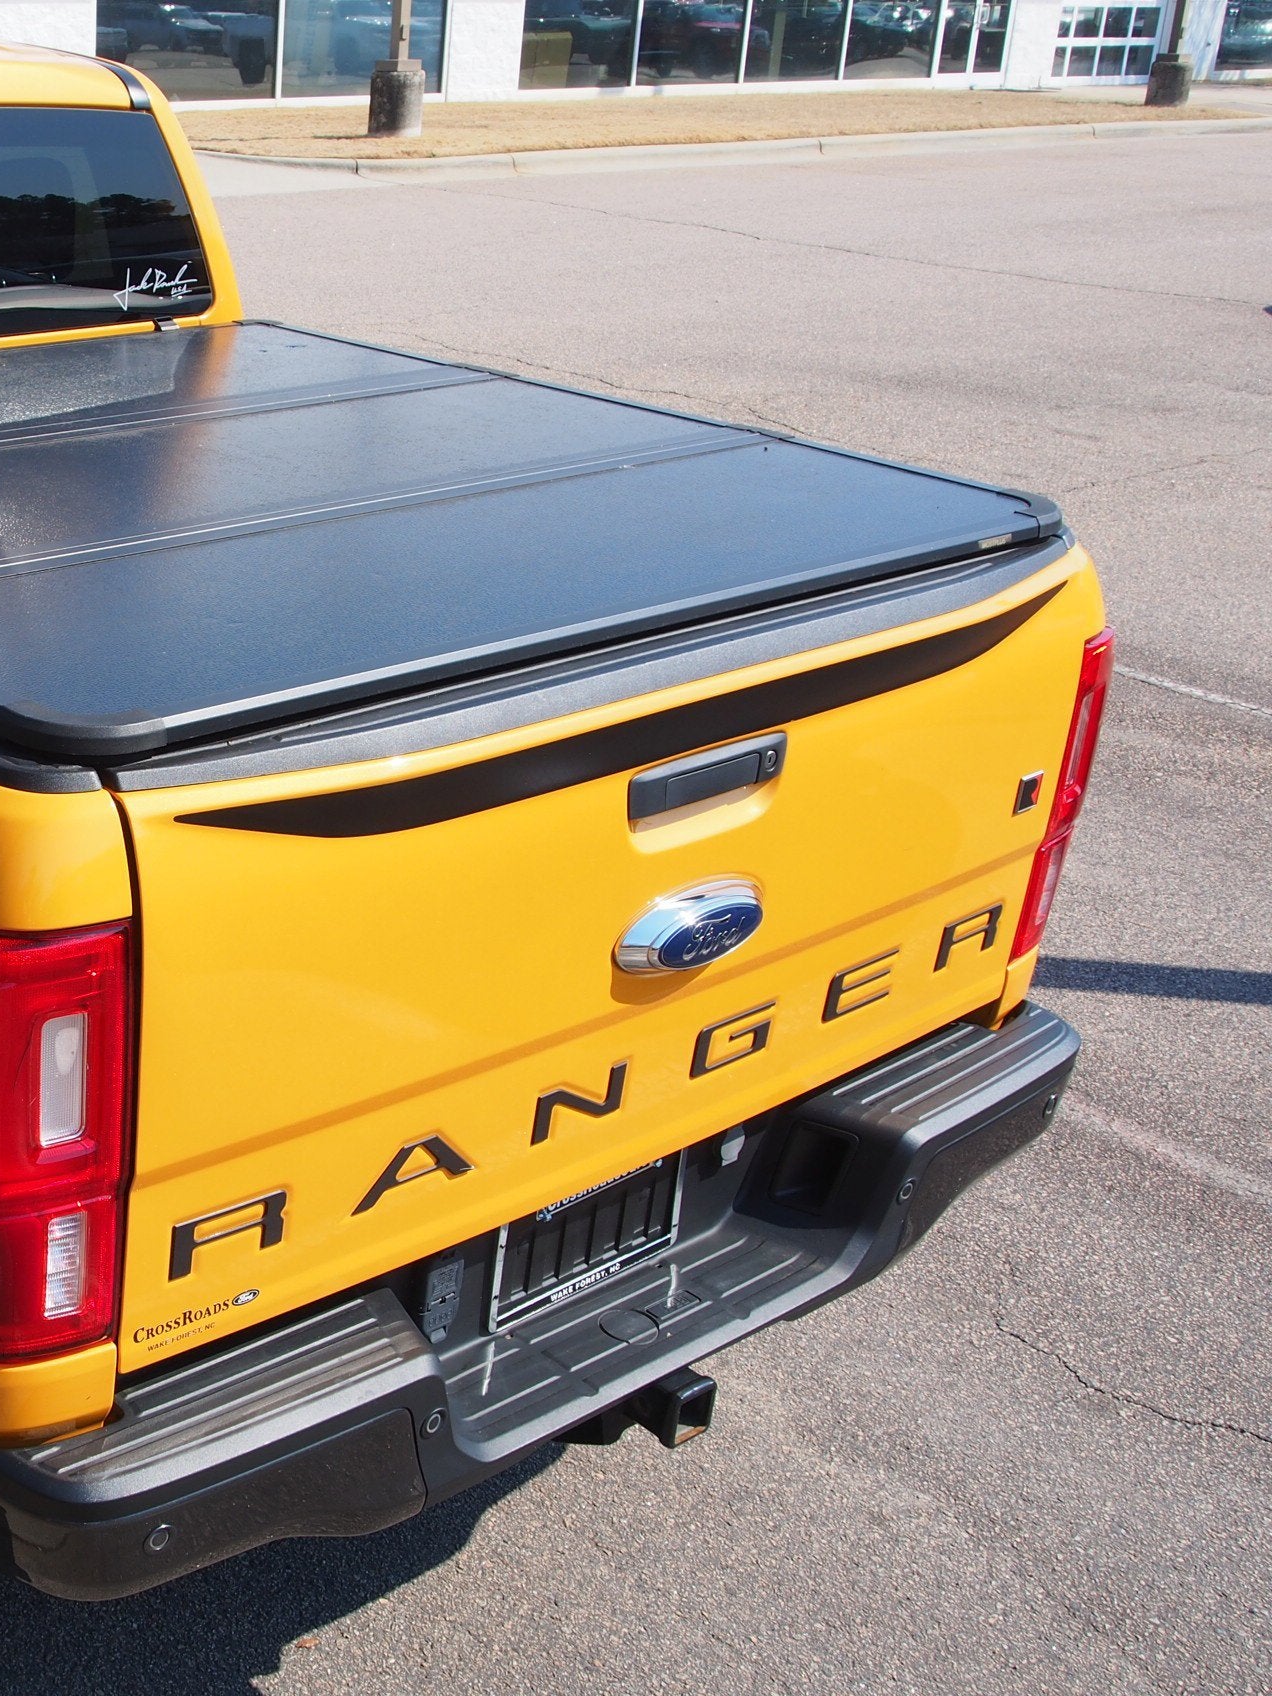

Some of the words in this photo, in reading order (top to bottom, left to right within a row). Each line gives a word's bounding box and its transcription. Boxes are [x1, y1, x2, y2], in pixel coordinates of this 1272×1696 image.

[683, 913, 746, 962] Ford
[168, 904, 1003, 1282] RANGER
[550, 1286, 574, 1302] WAKE
[609, 1262, 621, 1274] NC
